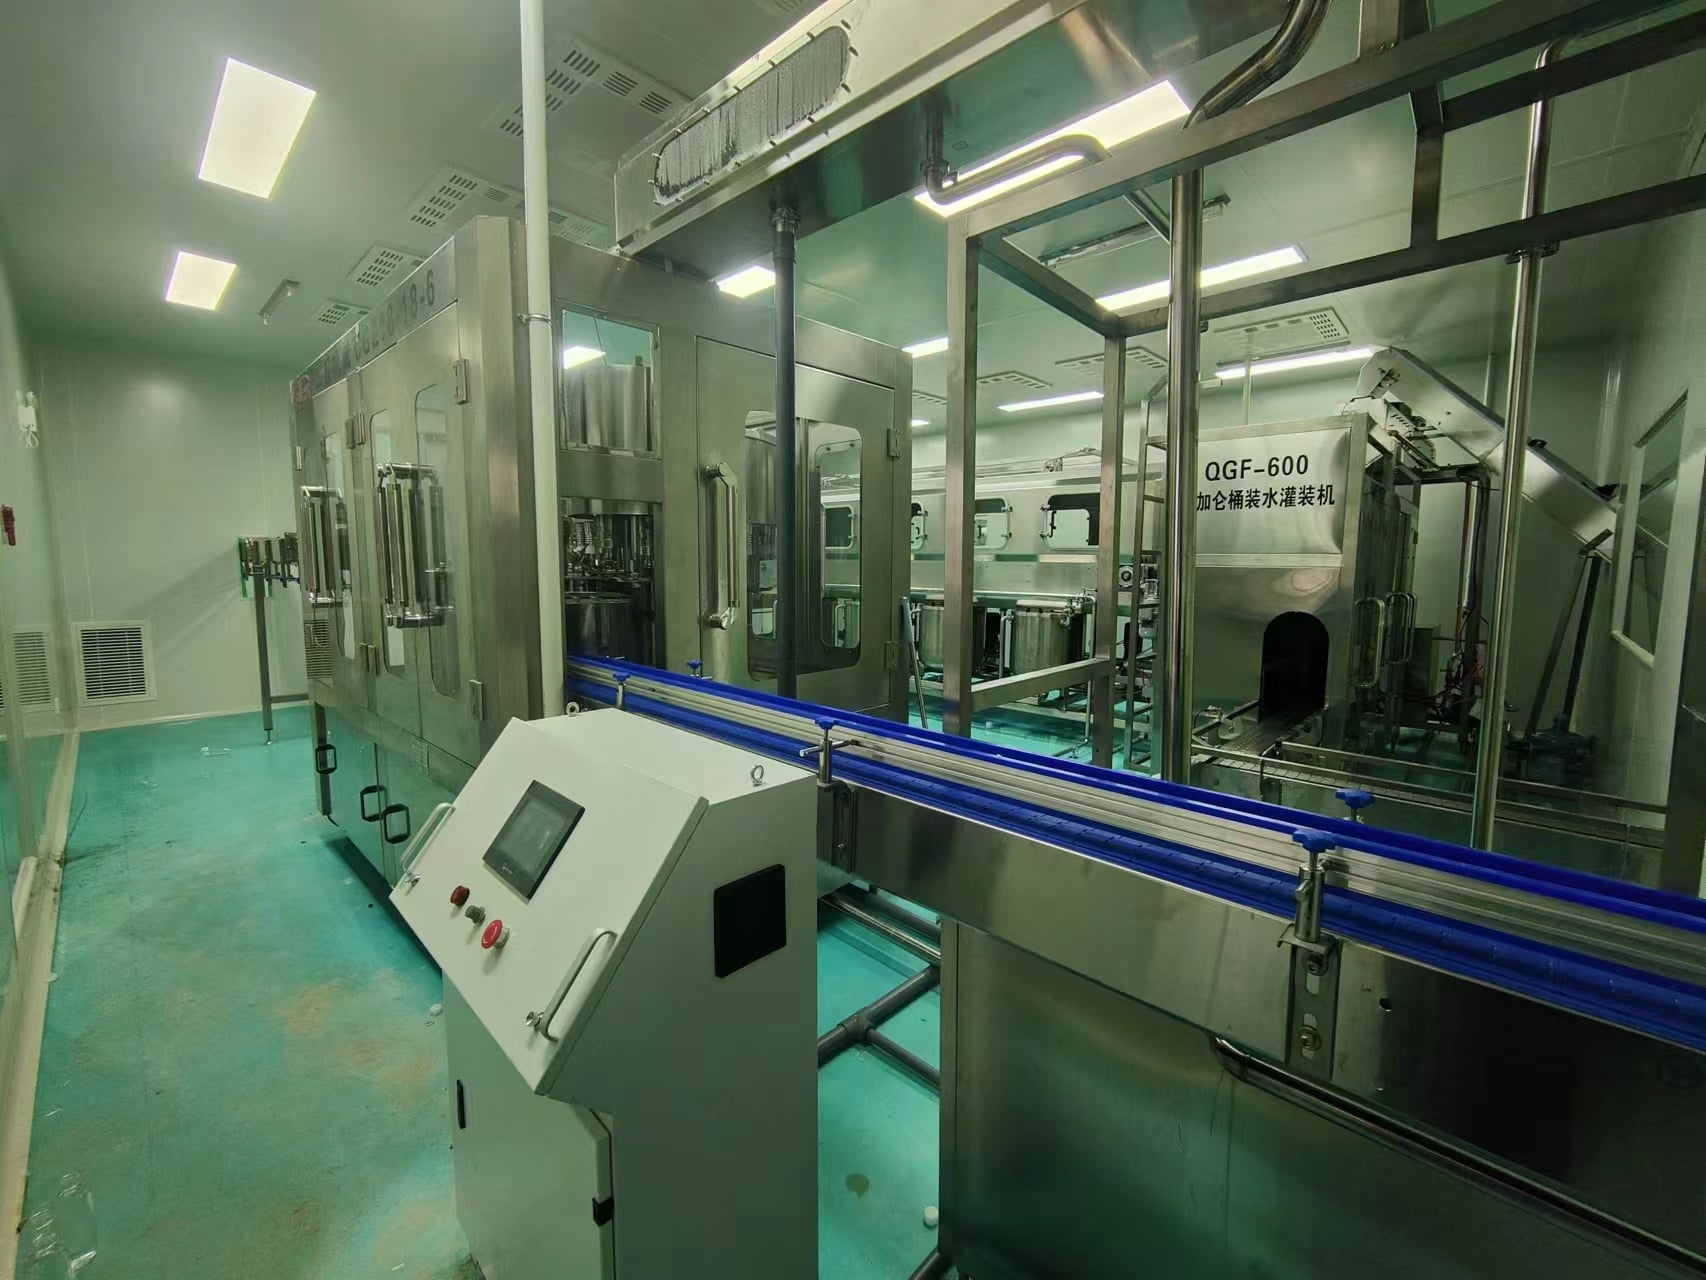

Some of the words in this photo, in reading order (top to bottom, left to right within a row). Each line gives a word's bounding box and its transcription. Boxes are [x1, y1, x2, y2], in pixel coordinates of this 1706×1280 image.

[1205, 454, 1309, 481] QGF-600
[1196, 483, 1335, 511] 加仑桶装水灌装机
